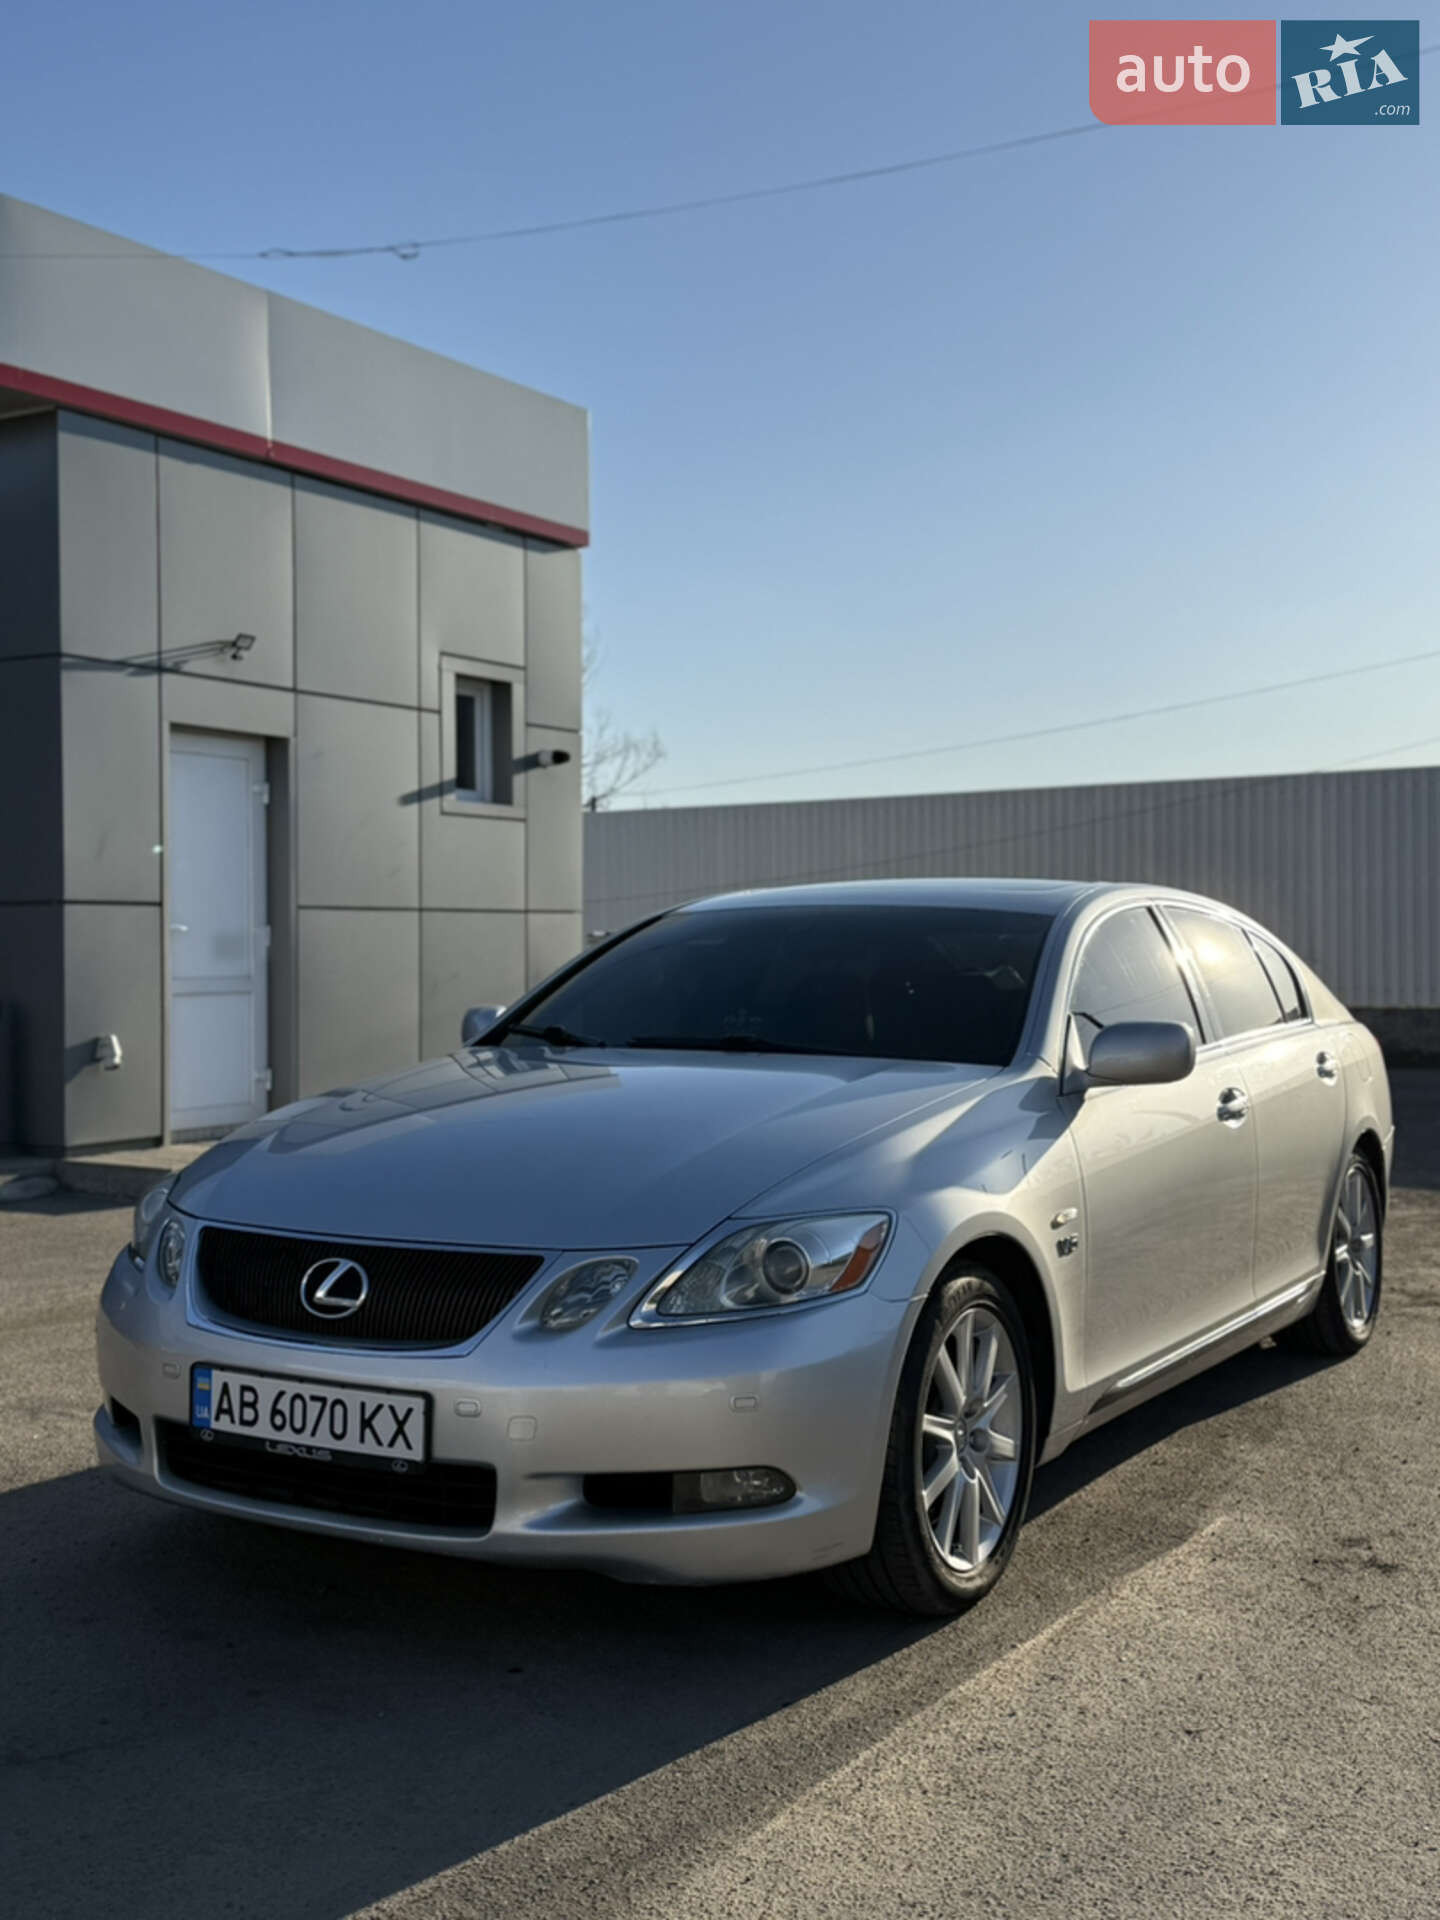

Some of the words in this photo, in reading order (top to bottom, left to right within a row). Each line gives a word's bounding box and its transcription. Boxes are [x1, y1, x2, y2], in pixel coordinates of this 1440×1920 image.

[214, 1381, 260, 1428] AB
[269, 1390, 348, 1441] 6070
[359, 1401, 414, 1451] KX
